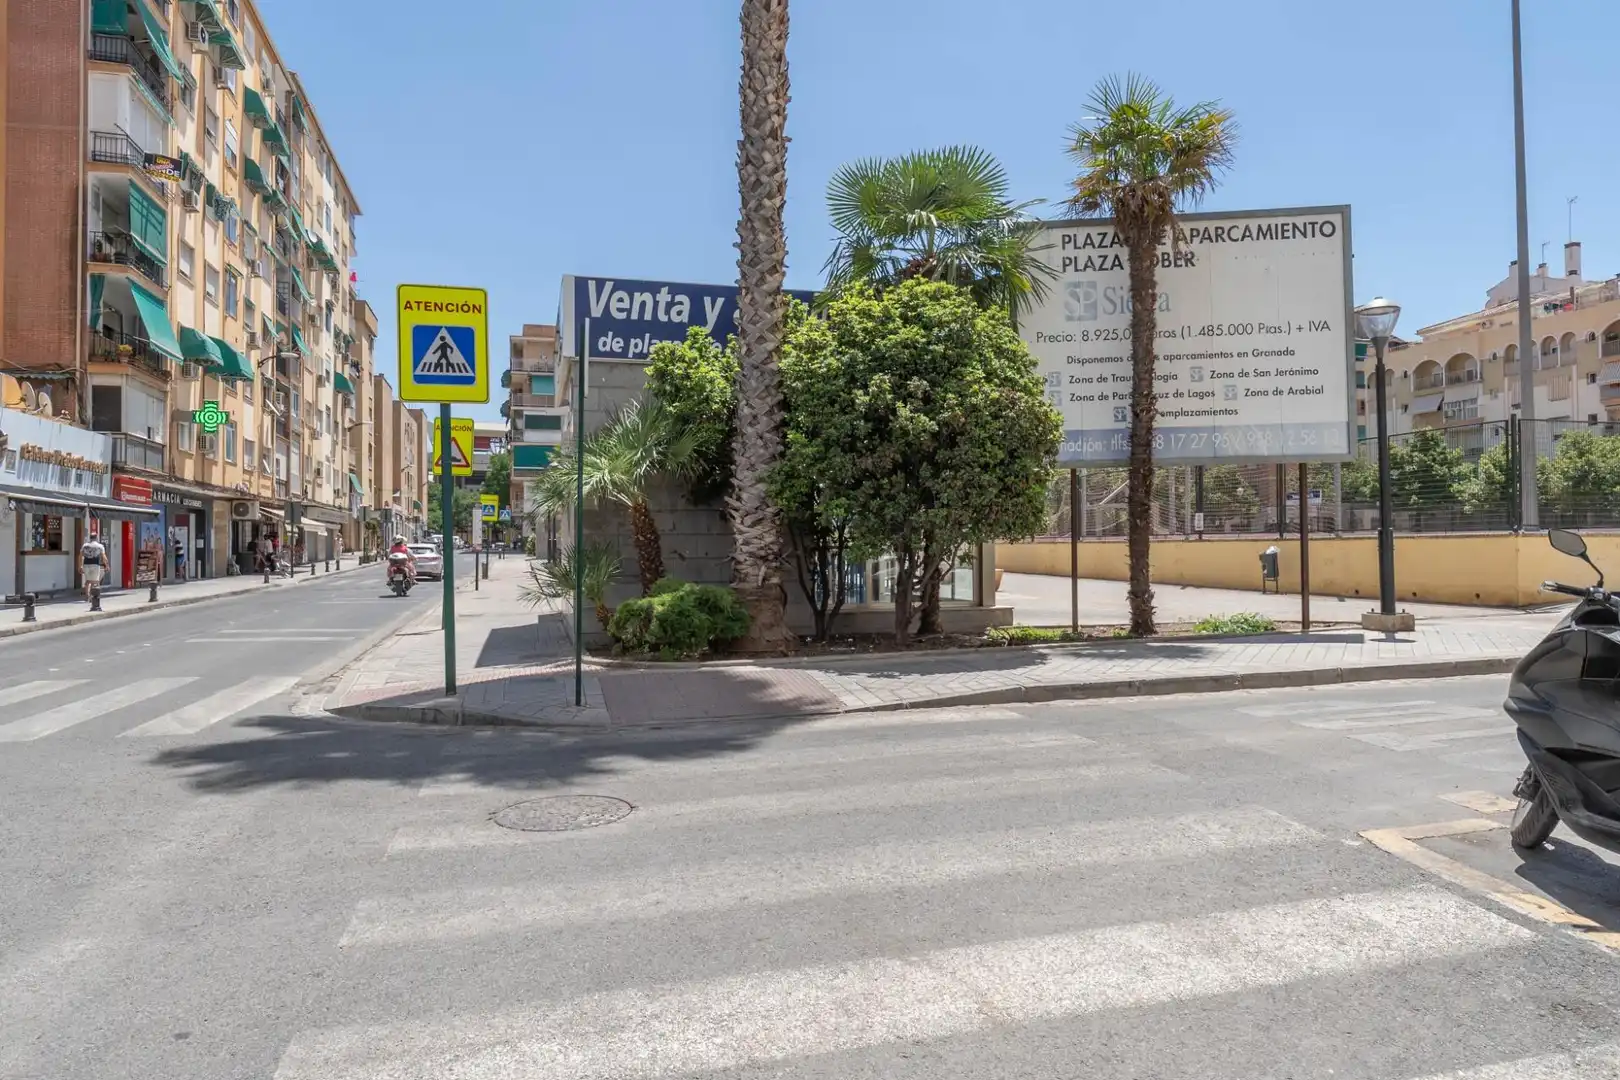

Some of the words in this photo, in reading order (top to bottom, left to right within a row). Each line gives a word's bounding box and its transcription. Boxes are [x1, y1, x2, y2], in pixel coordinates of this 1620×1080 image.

[1176, 220, 1336, 245] APARCAMIENTO
[1062, 253, 1124, 273] PLAZA
[403, 300, 483, 314] ATENCIÓN
[587, 279, 691, 324] Venta
[703, 296, 725, 334] y
[1102, 286, 1171, 315] Siea
[1036, 331, 1077, 344] Precio:
[1081, 328, 1134, 343] 8.925,0
[1181, 322, 1254, 339] (1.485.000
[1308, 320, 1331, 332] IVA
[597, 331, 625, 353] de
[1066, 355, 1124, 365] Disponemos
[1163, 350, 1234, 363] aparcamientos
[1236, 351, 1249, 359] en
[1252, 347, 1295, 358] Granada
[1068, 374, 1094, 384] Zona
[1096, 374, 1109, 384] de
[1210, 370, 1235, 380] Zona
[1238, 368, 1250, 378] de
[1253, 368, 1271, 377] San
[1274, 367, 1319, 377] Jerónimo
[1069, 393, 1095, 402] Zona
[1097, 392, 1110, 401] de
[1173, 388, 1185, 398] de
[1187, 388, 1215, 400] Lagos
[1244, 388, 1269, 397] Zona
[1272, 386, 1284, 396] de
[1287, 385, 1324, 396] Arabial
[1170, 434, 1186, 450] 17
[1191, 433, 1208, 448] 27
